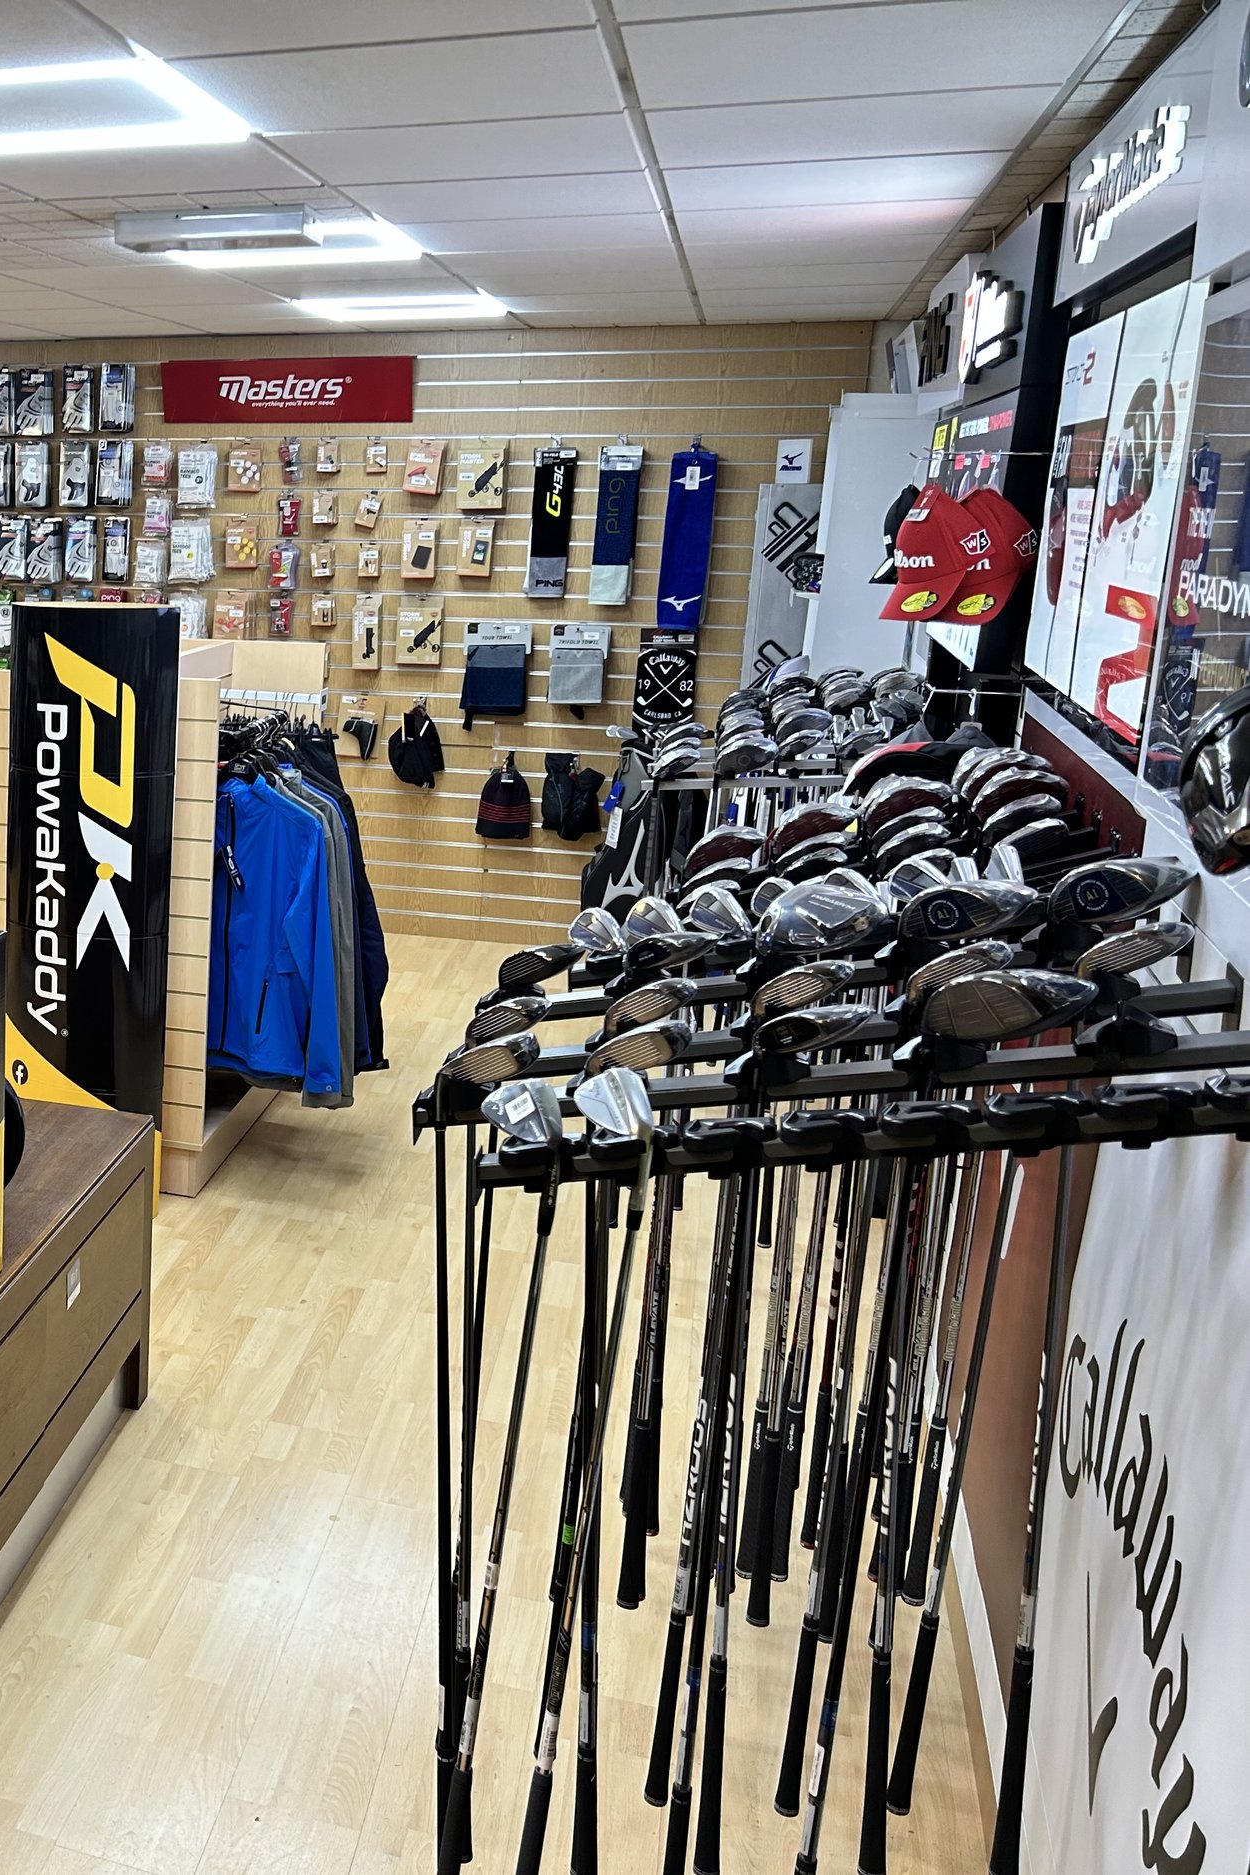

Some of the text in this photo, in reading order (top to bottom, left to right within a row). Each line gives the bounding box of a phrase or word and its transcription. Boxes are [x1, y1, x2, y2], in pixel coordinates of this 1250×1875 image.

[285, 400, 301, 408] you'll
[605, 477, 626, 534] ping
[534, 579, 563, 587] PING
[648, 653, 686, 667] Callaway
[637, 679, 651, 690] 19
[679, 680, 694, 691] 82
[643, 708, 672, 719] CARLSBAD
[43, 631, 136, 972] PK
[28, 702, 69, 1036] PowaKaddy
[1057, 1316, 1207, 1873] Callaway
